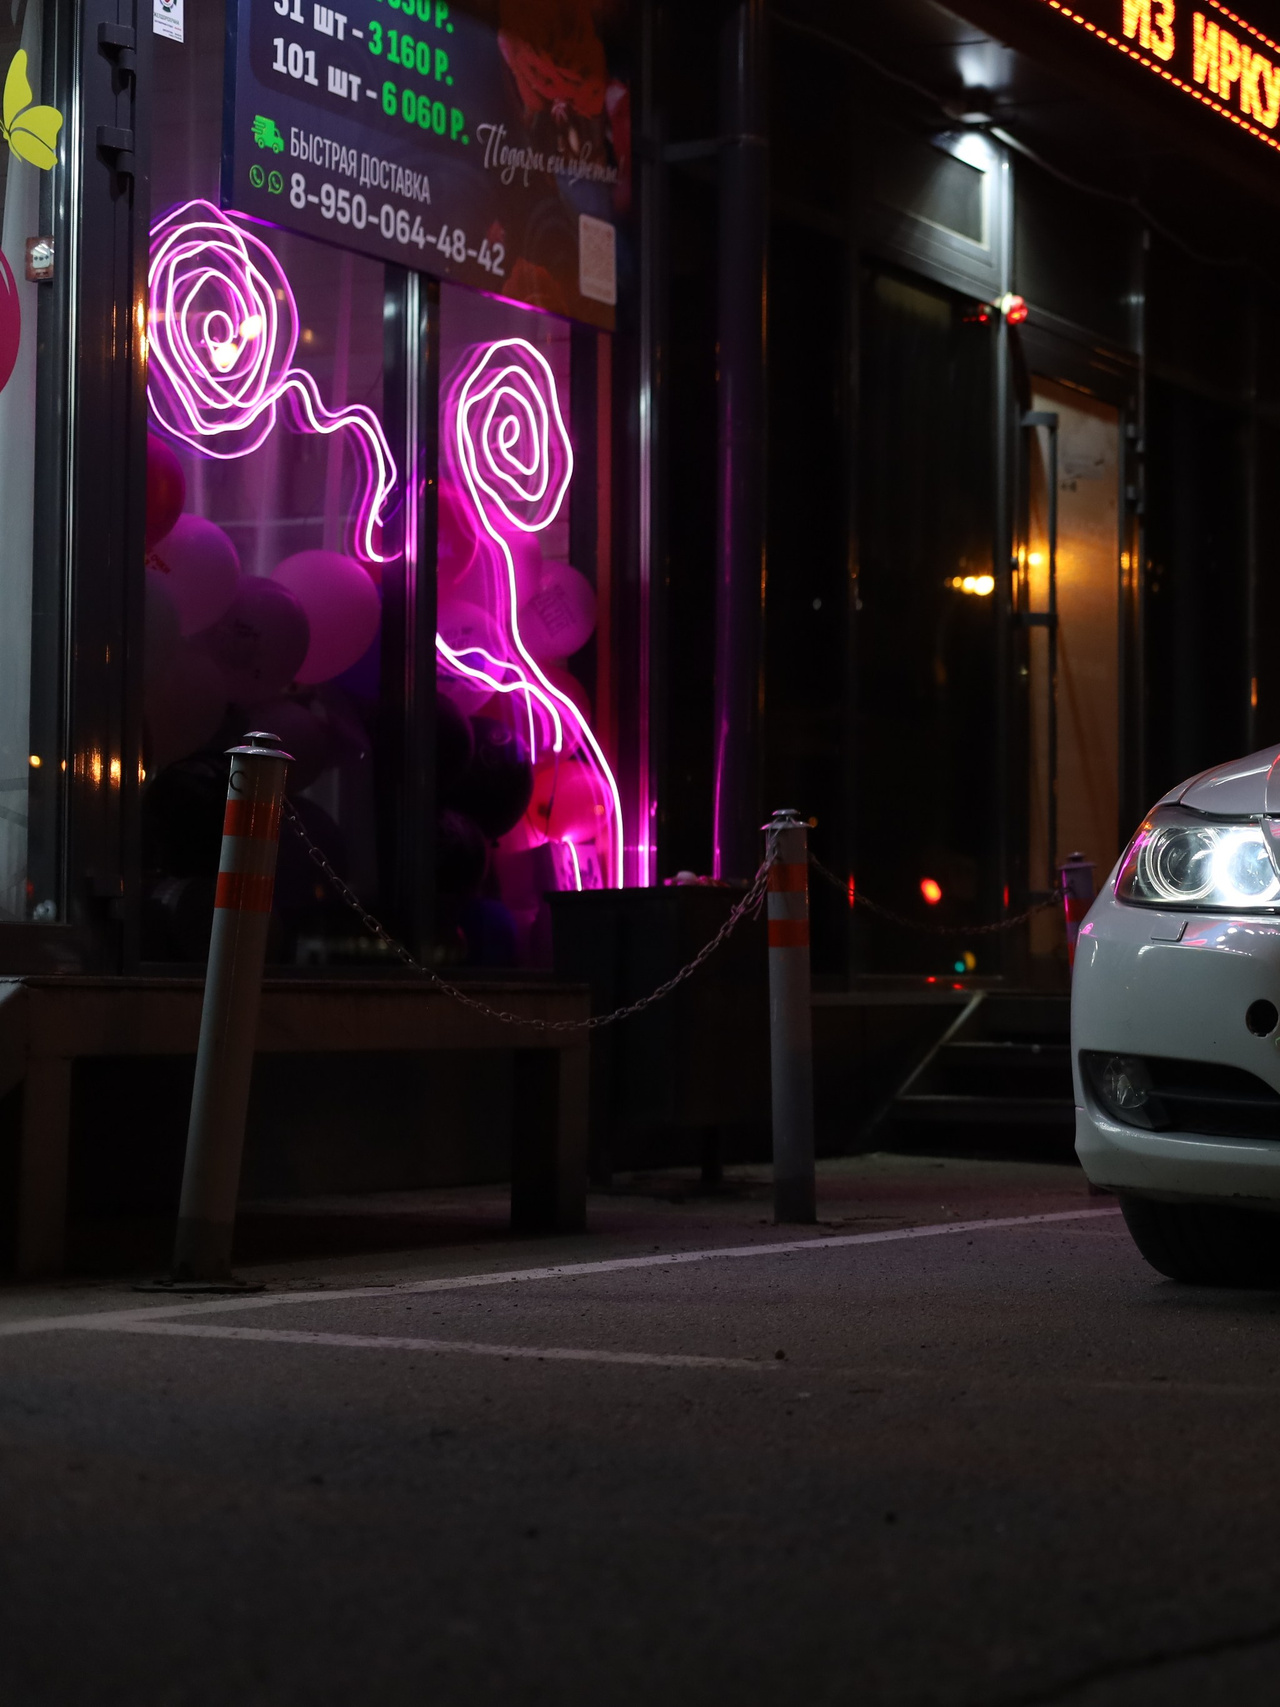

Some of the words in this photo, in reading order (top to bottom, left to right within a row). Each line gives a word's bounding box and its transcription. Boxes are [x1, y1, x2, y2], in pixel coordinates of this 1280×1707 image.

[272, 37, 319, 87] 101
[1122, 0, 1176, 61] ИЗ
[290, 126, 358, 179] БЫСТРАЯ
[359, 152, 431, 205] ДОСТАВКА
[289, 172, 506, 277] 8-950-064-48-42
